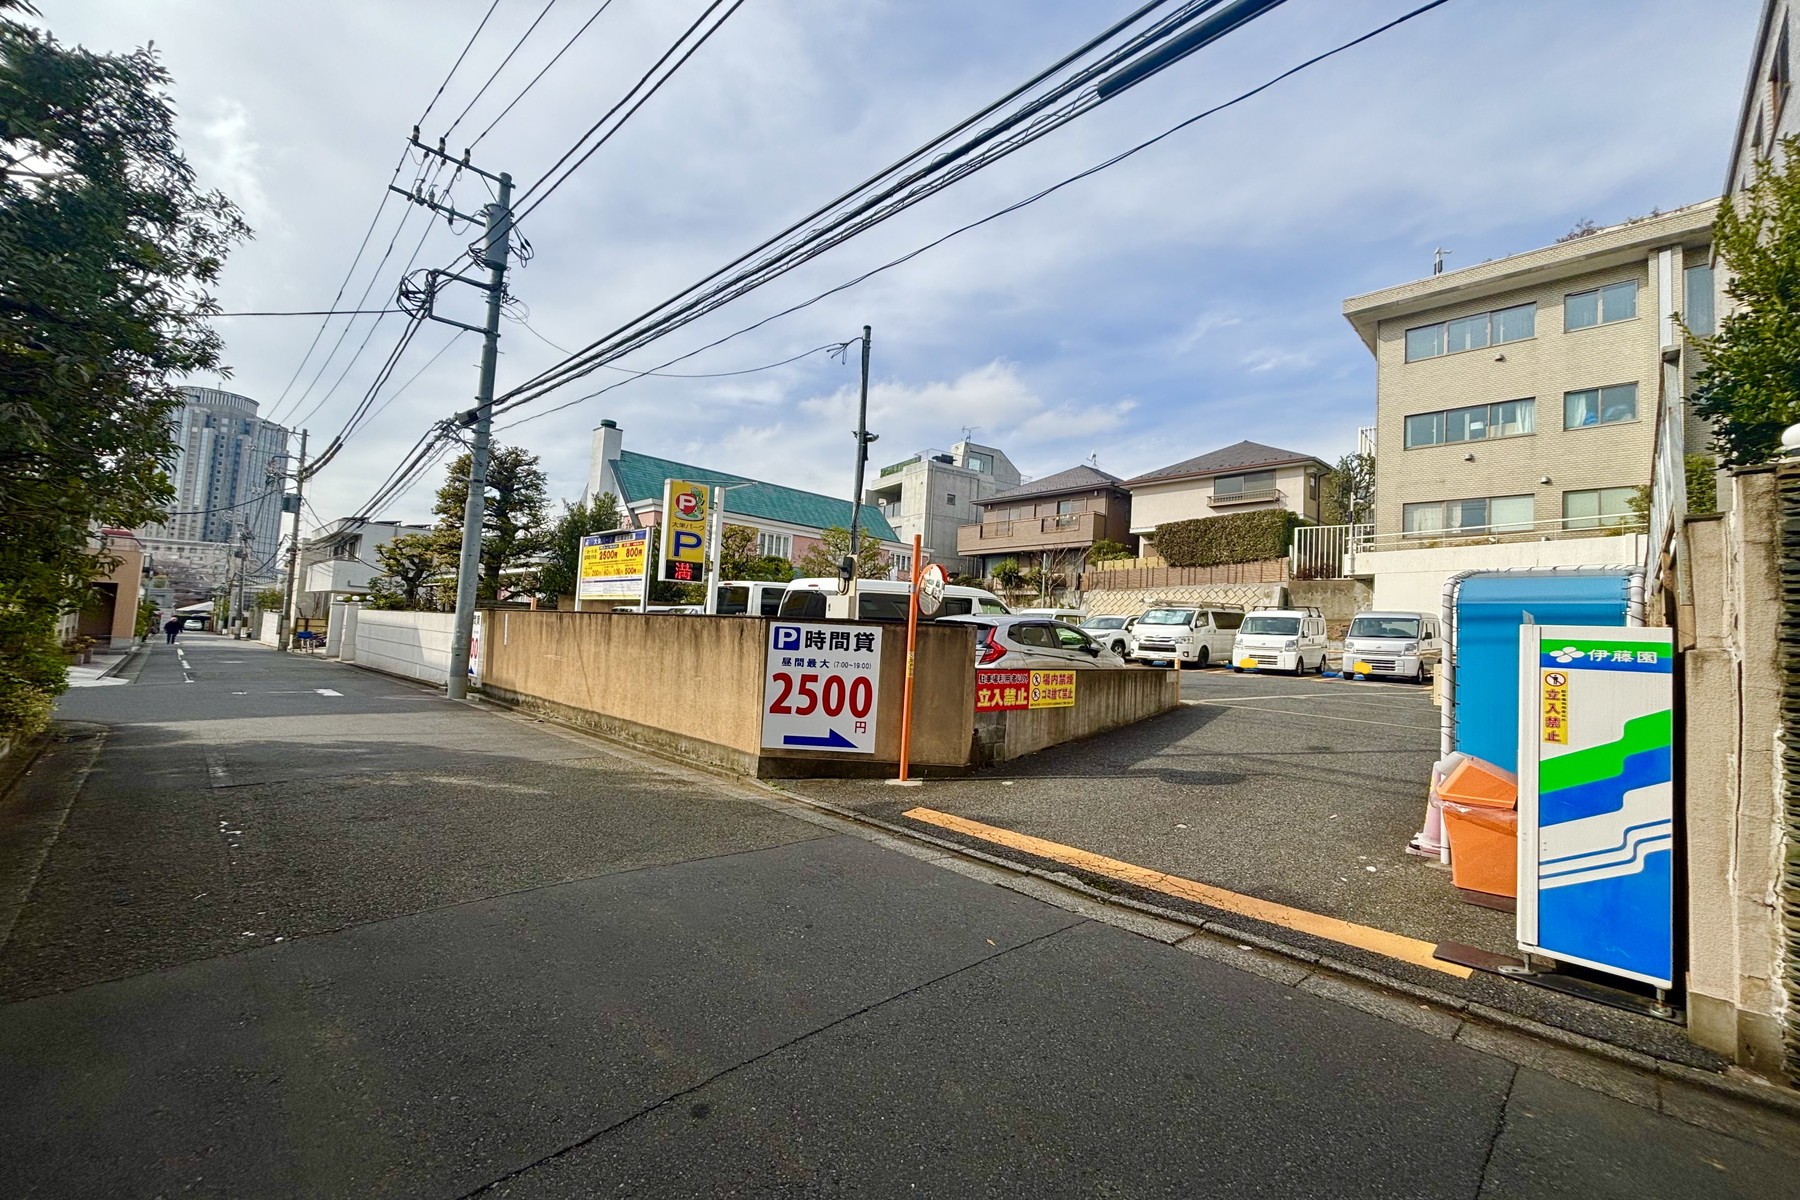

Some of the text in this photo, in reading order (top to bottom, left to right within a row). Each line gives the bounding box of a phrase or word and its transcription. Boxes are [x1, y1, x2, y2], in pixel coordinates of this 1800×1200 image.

[679, 494, 697, 510] P
[671, 521, 705, 531] 大栄パーク
[673, 530, 702, 557] P
[674, 562, 693, 580] 満
[777, 628, 875, 653] P 時間貸
[781, 656, 830, 669] 昼間最大
[1587, 649, 1658, 664] 伊藤園
[1042, 673, 1074, 686] 場内禁煙
[769, 672, 873, 719] 2500
[977, 687, 1028, 708] 立入禁止
[1041, 687, 1073, 700] ゴミ捨て禁止
[1544, 688, 1561, 743] 立入禁止
[854, 720, 867, 734] 円
